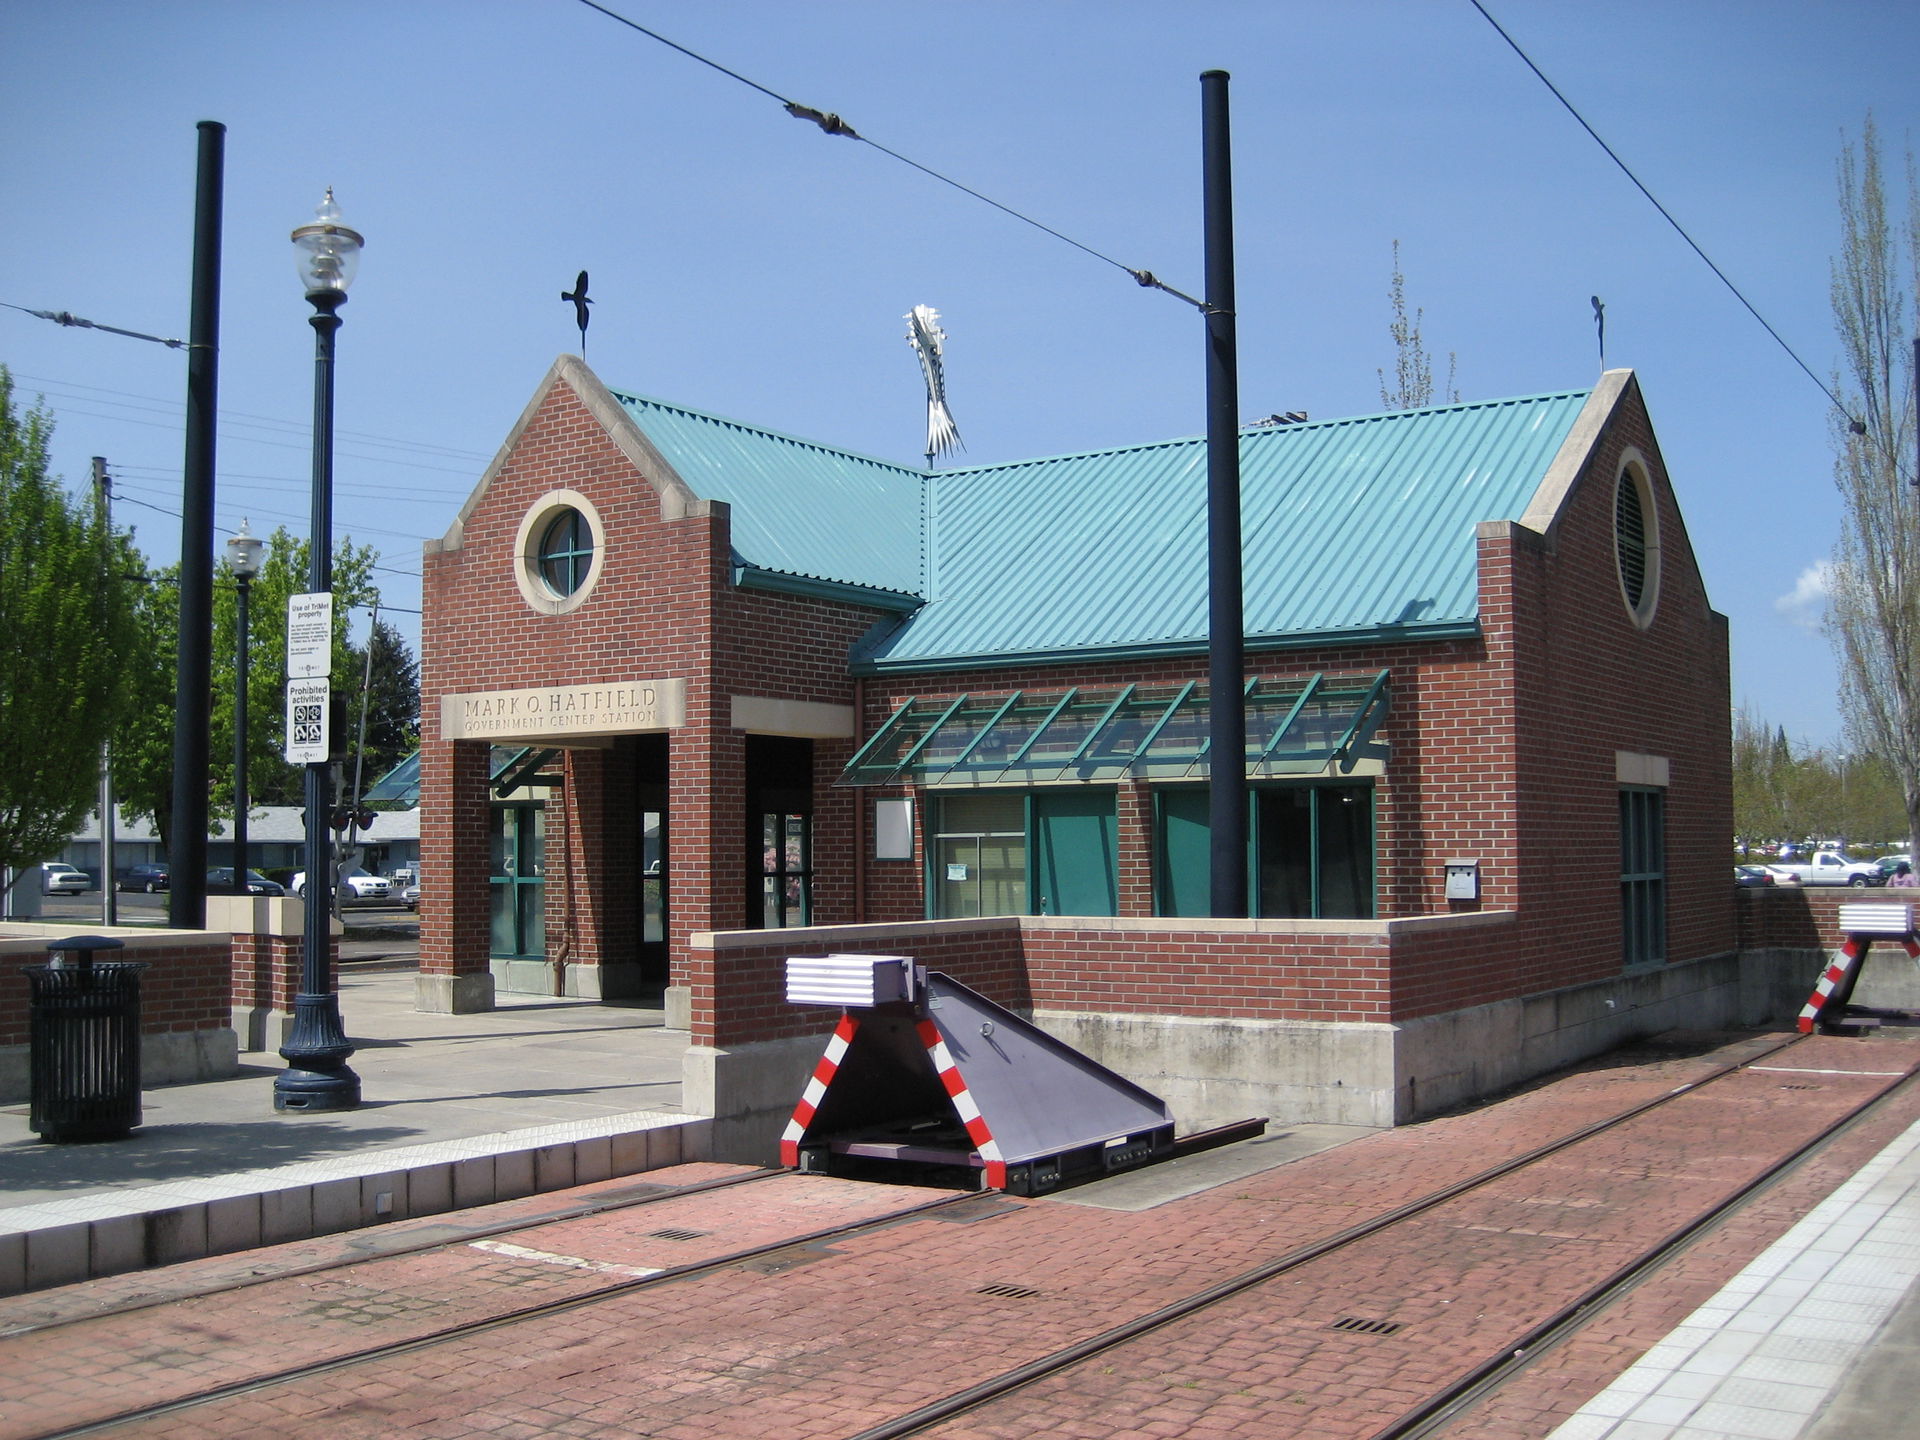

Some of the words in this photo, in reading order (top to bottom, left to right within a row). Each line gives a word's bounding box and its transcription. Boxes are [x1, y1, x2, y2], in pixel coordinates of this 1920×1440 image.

[298, 610, 322, 619] property
[290, 685, 327, 695] Prohibited
[292, 695, 325, 704] activities
[465, 697, 520, 717] MARK
[527, 696, 542, 713] O.
[549, 688, 656, 712] HATFIELD
[465, 716, 544, 731] GOVERNMENT
[550, 713, 595, 727] CENTER
[602, 710, 657, 724] STATION
